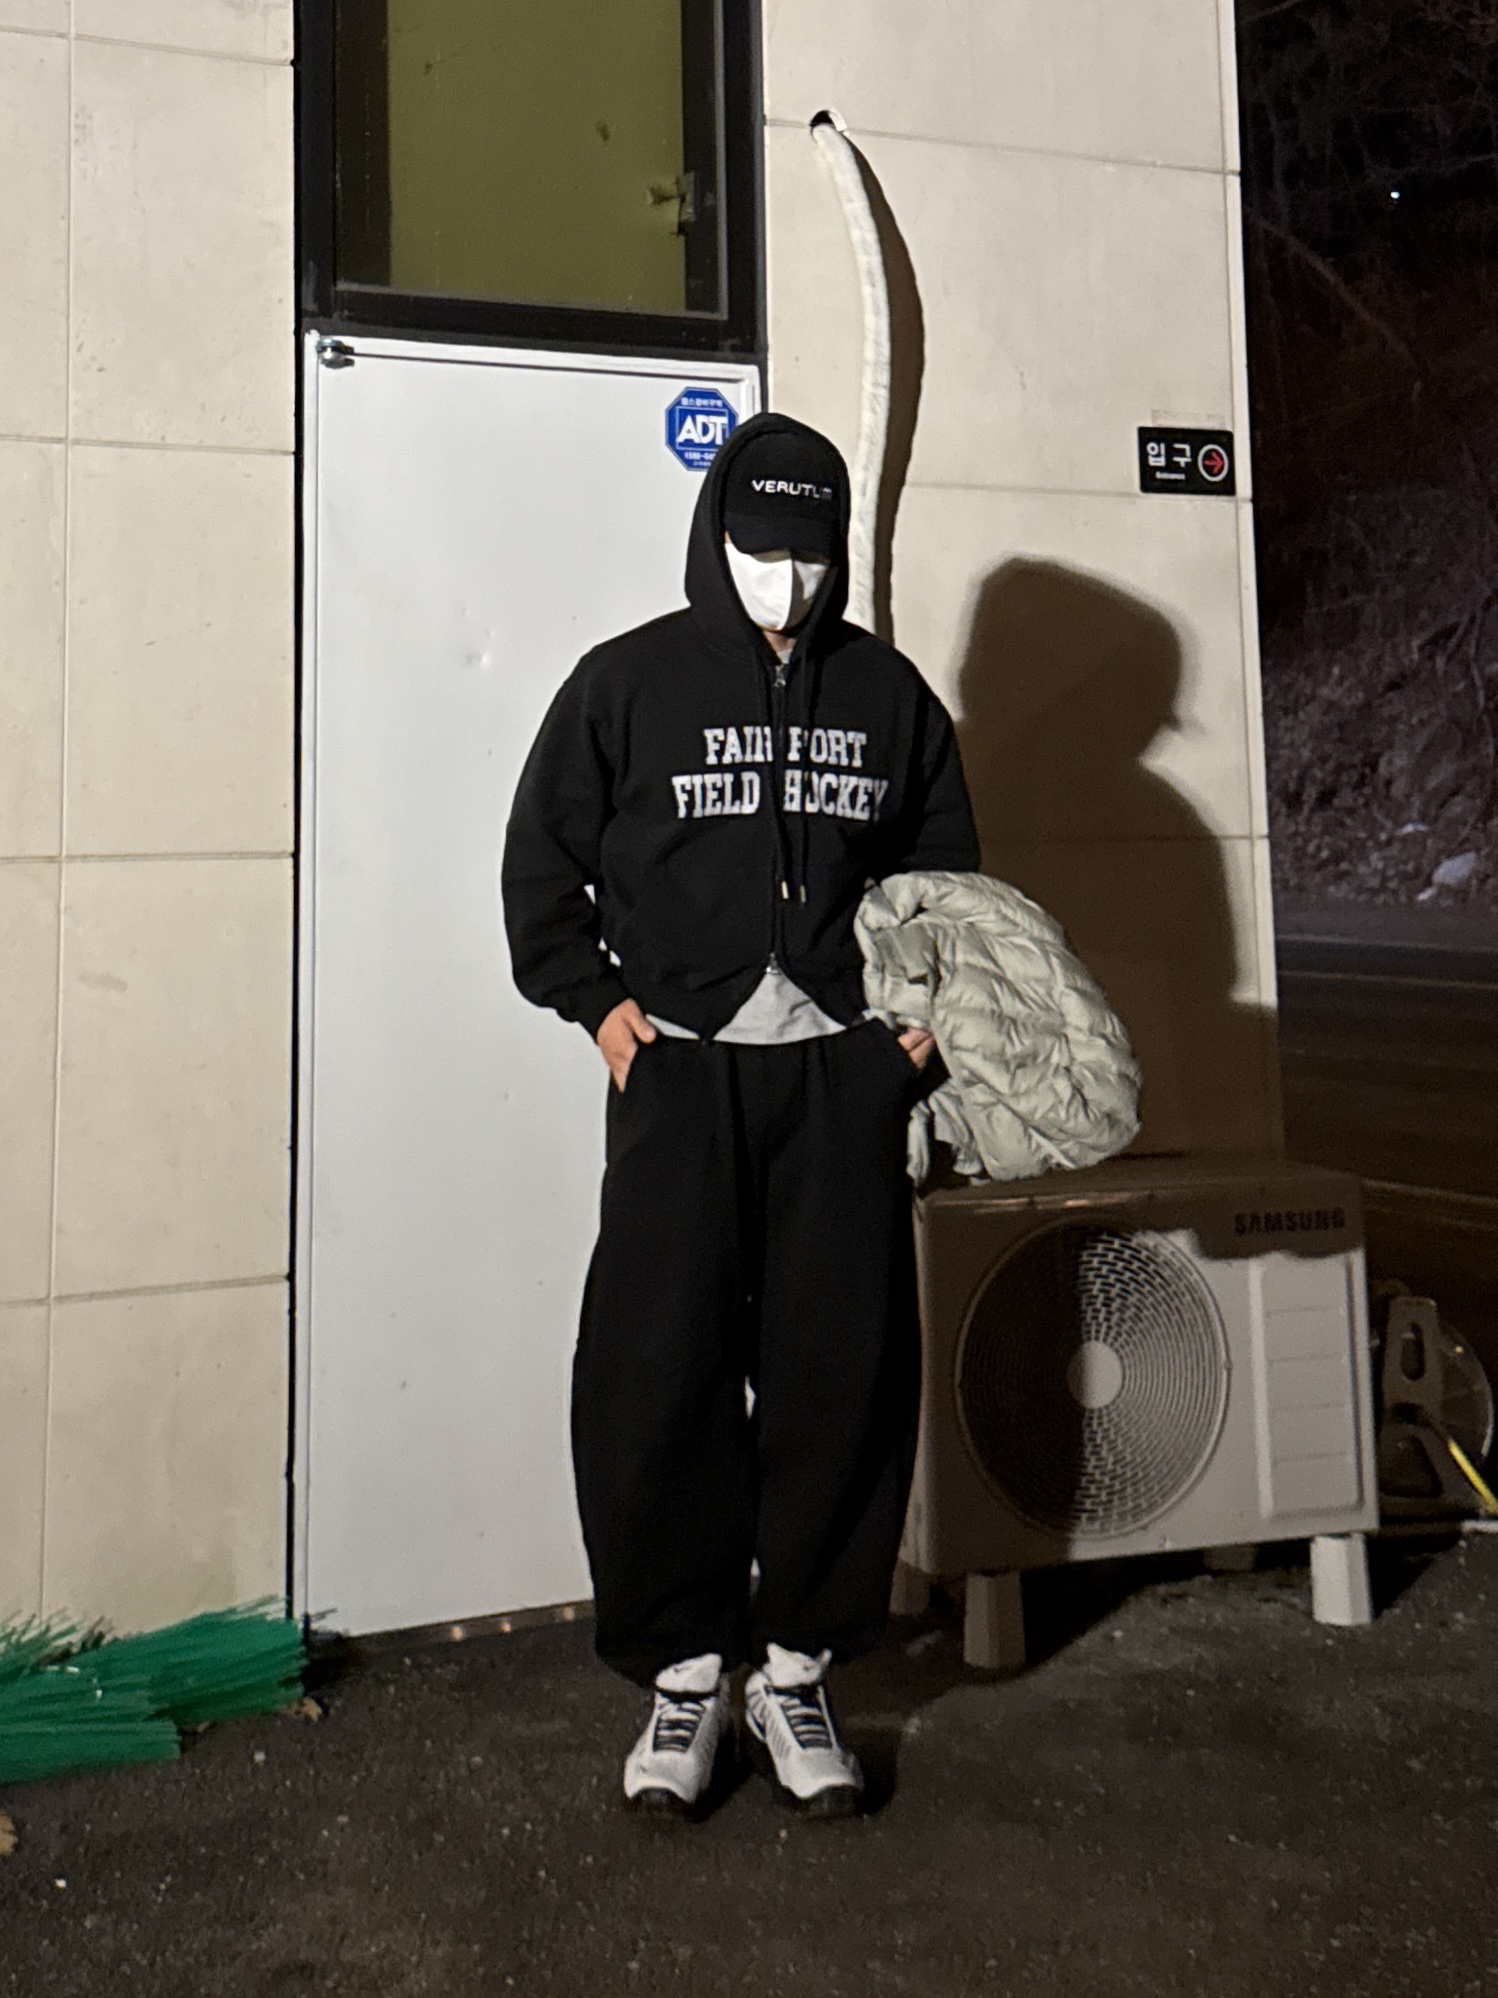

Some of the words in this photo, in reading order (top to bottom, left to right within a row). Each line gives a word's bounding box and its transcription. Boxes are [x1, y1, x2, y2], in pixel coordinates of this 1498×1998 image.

[675, 414, 728, 445] ADT
[1146, 442, 1192, 468] 입구
[671, 771, 760, 819] FIELD
[783, 768, 889, 822] HOCKEY
[1234, 1206, 1345, 1237] SAMSUNG
